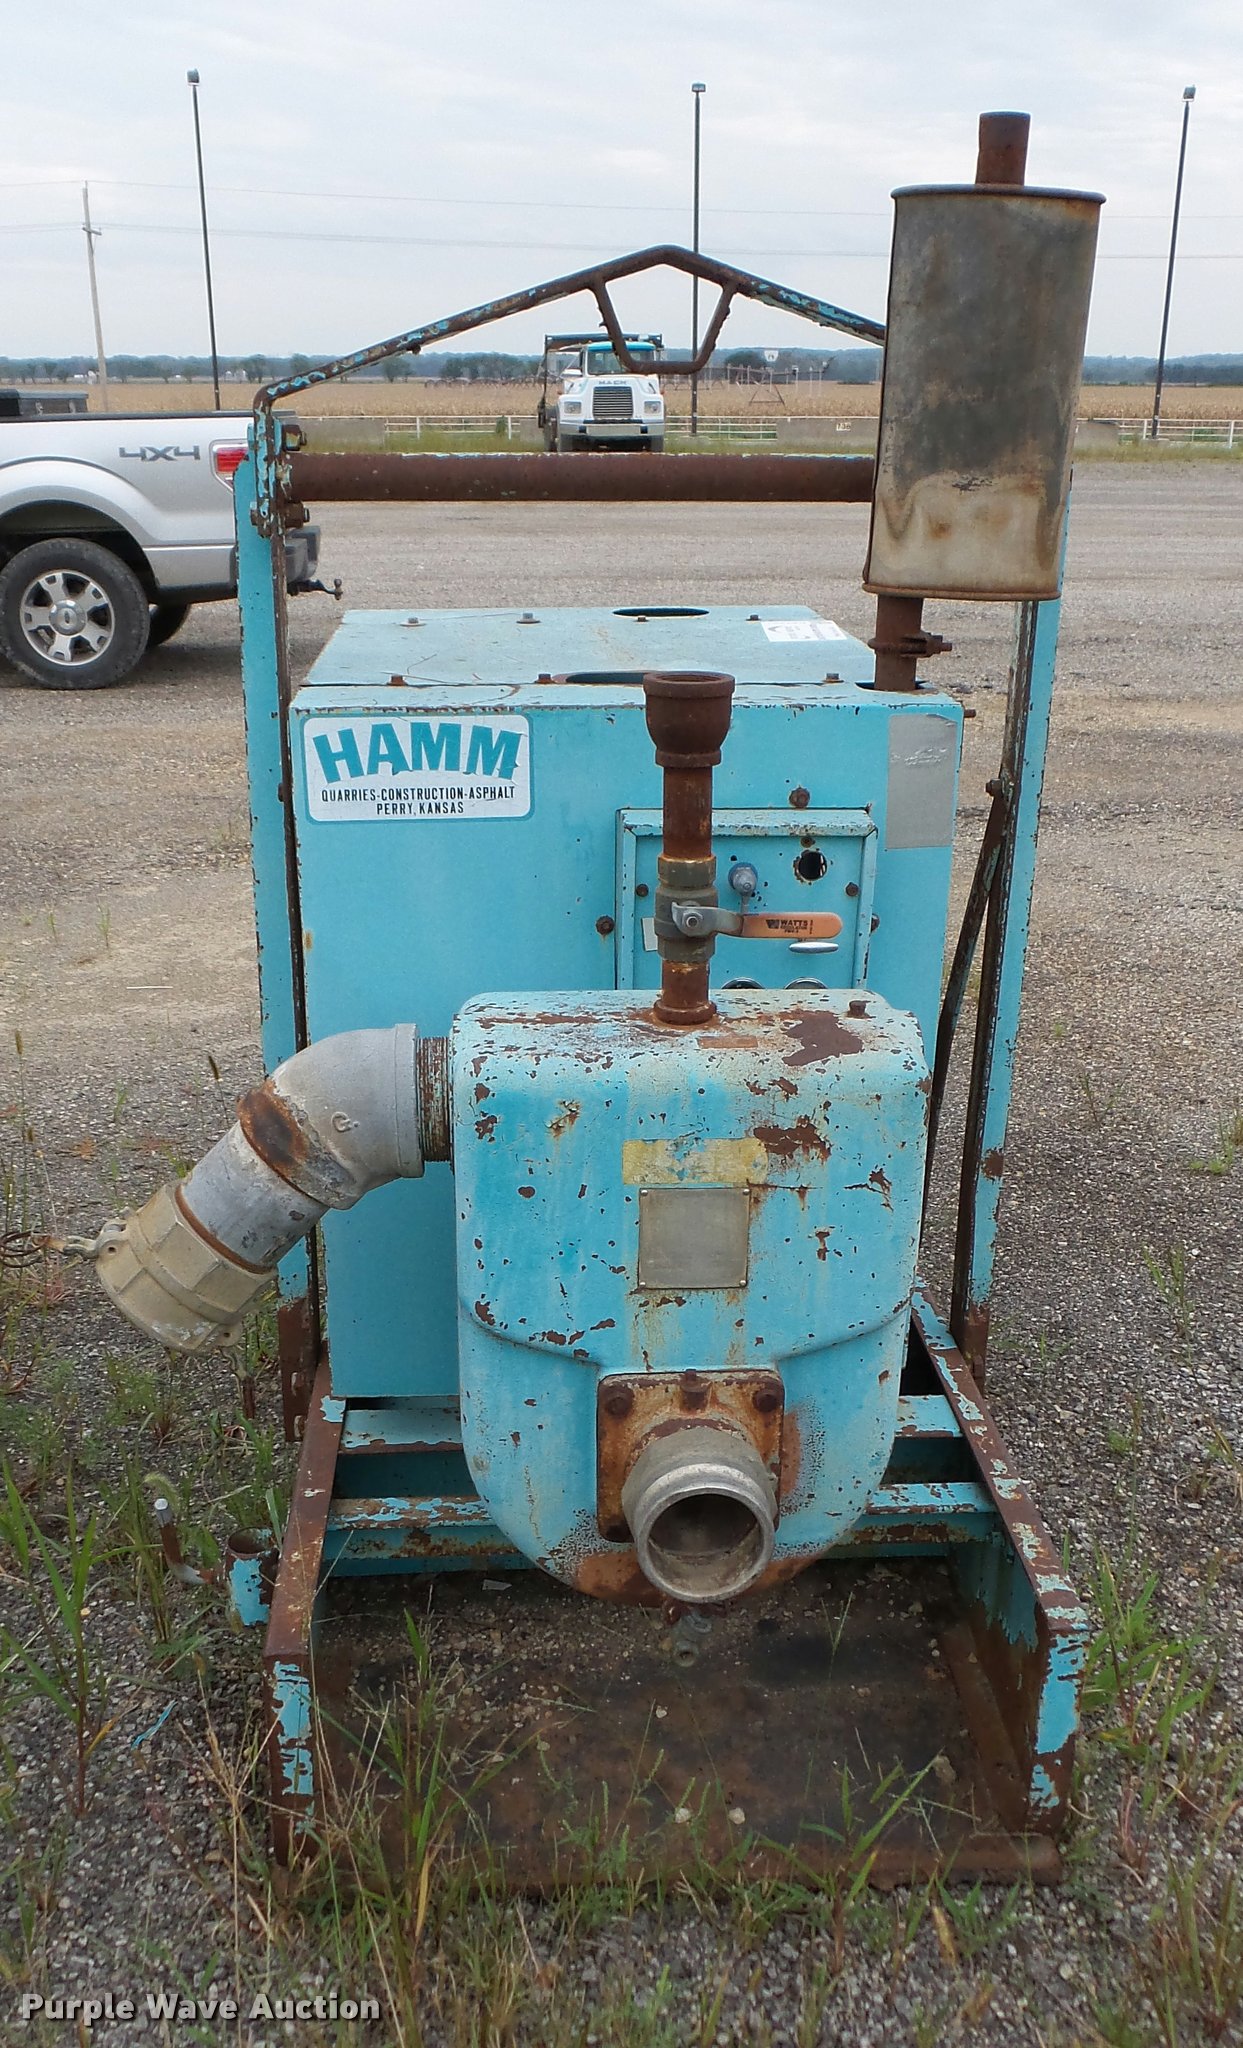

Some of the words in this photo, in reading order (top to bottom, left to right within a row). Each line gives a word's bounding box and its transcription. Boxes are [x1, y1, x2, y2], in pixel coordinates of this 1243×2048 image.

[313, 722, 523, 784] HAMM
[376, 803, 417, 816] PERRY,
[419, 801, 464, 815] KANSAS
[780, 919, 808, 927] WATTS
